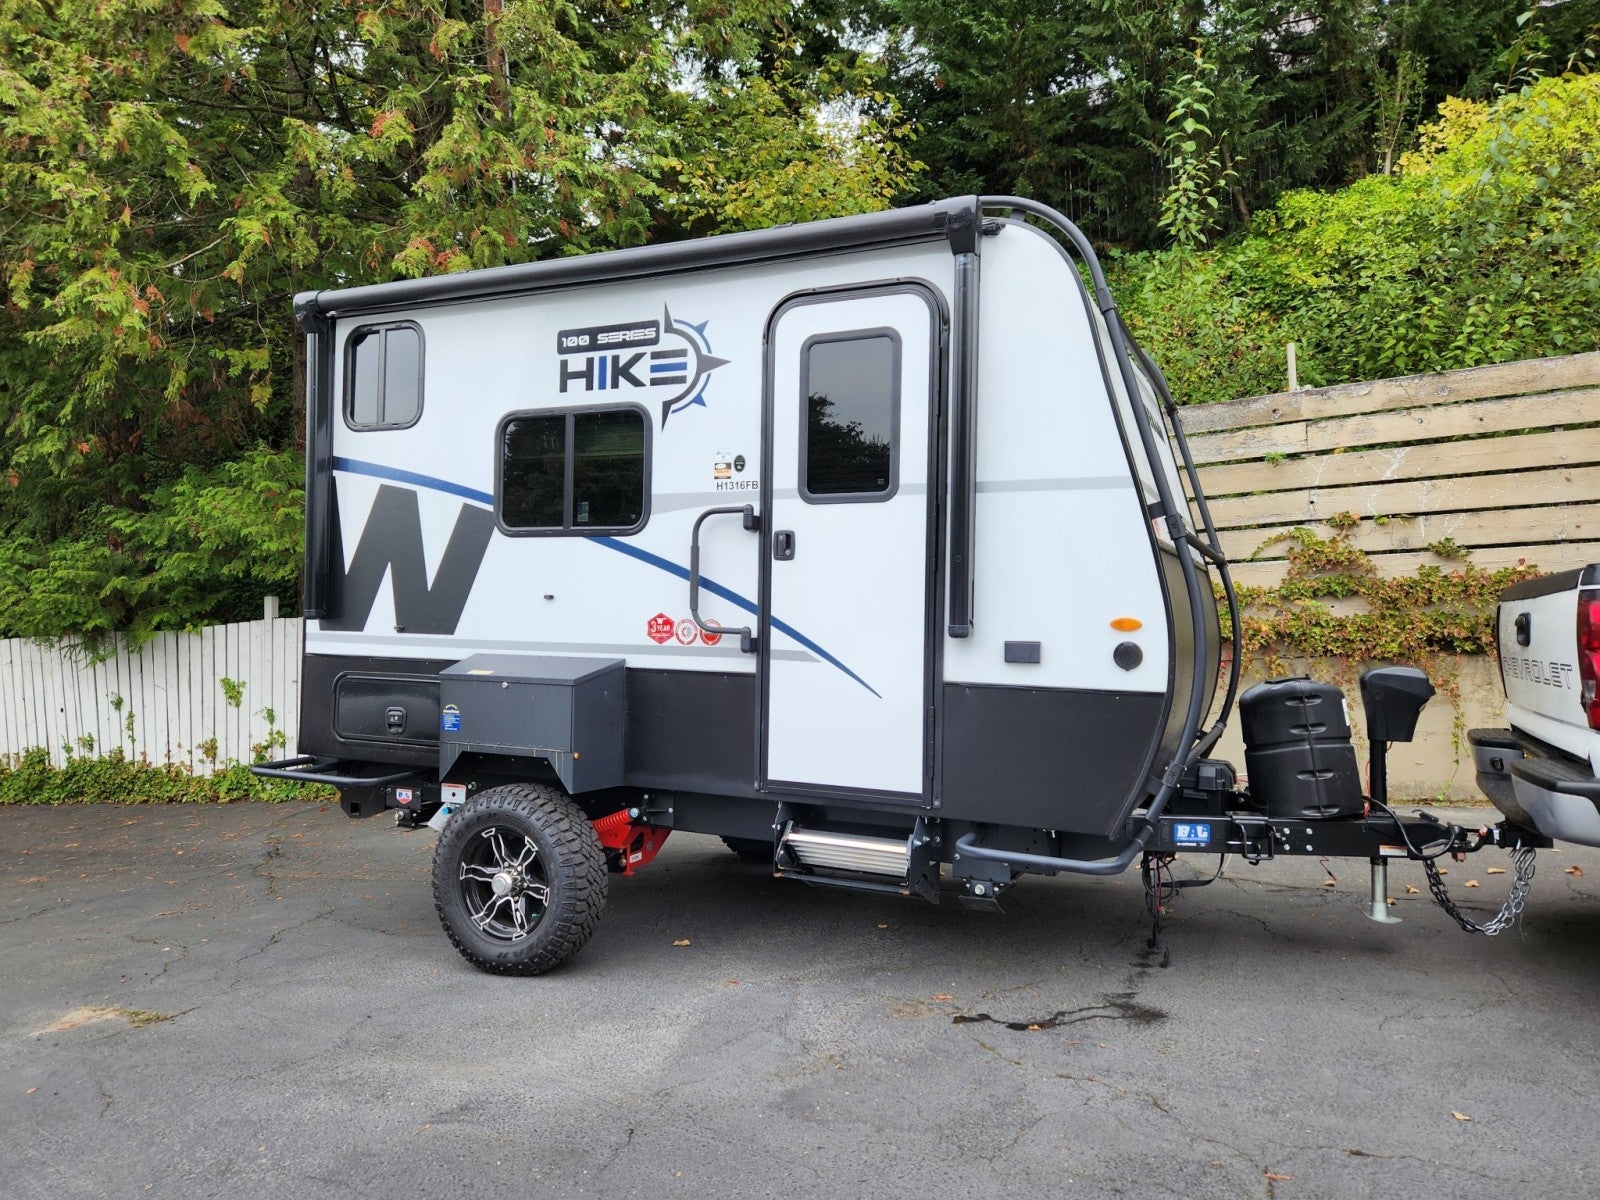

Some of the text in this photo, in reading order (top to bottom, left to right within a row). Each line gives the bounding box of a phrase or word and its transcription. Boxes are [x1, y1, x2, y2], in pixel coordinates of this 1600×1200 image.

[562, 327, 657, 348] 100 SERIES
[559, 349, 688, 393] HIKE
[716, 480, 759, 491] H1316FB
[650, 620, 657, 633] 3
